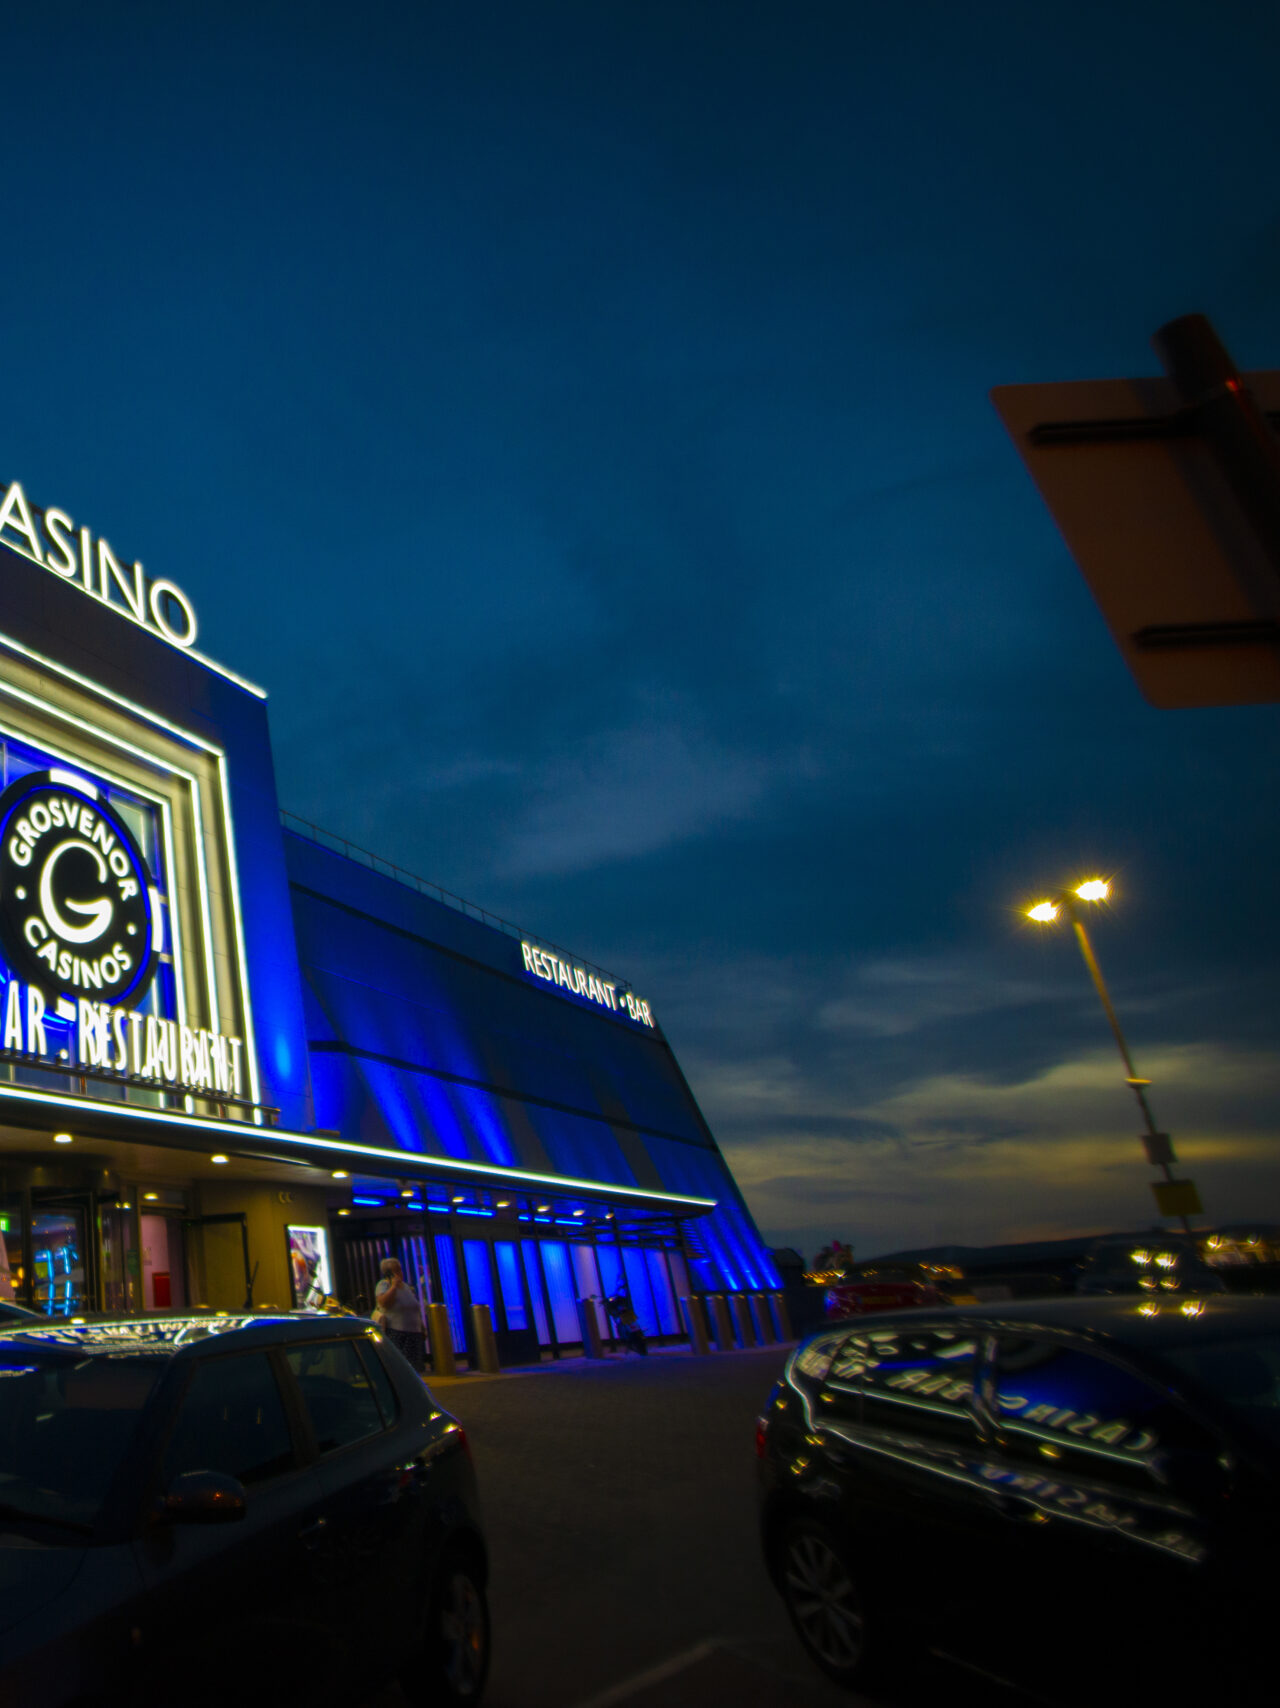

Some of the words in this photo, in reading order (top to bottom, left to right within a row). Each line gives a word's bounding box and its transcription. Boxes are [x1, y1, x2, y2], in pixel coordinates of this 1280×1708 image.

[9, 799, 138, 901] GROSVENOR
[40, 840, 113, 943] G
[24, 917, 132, 989] CASINOS
[521, 940, 616, 1011] RESTAURANT
[626, 992, 655, 1028] BAR
[79, 997, 243, 1096] RESTAURANT
